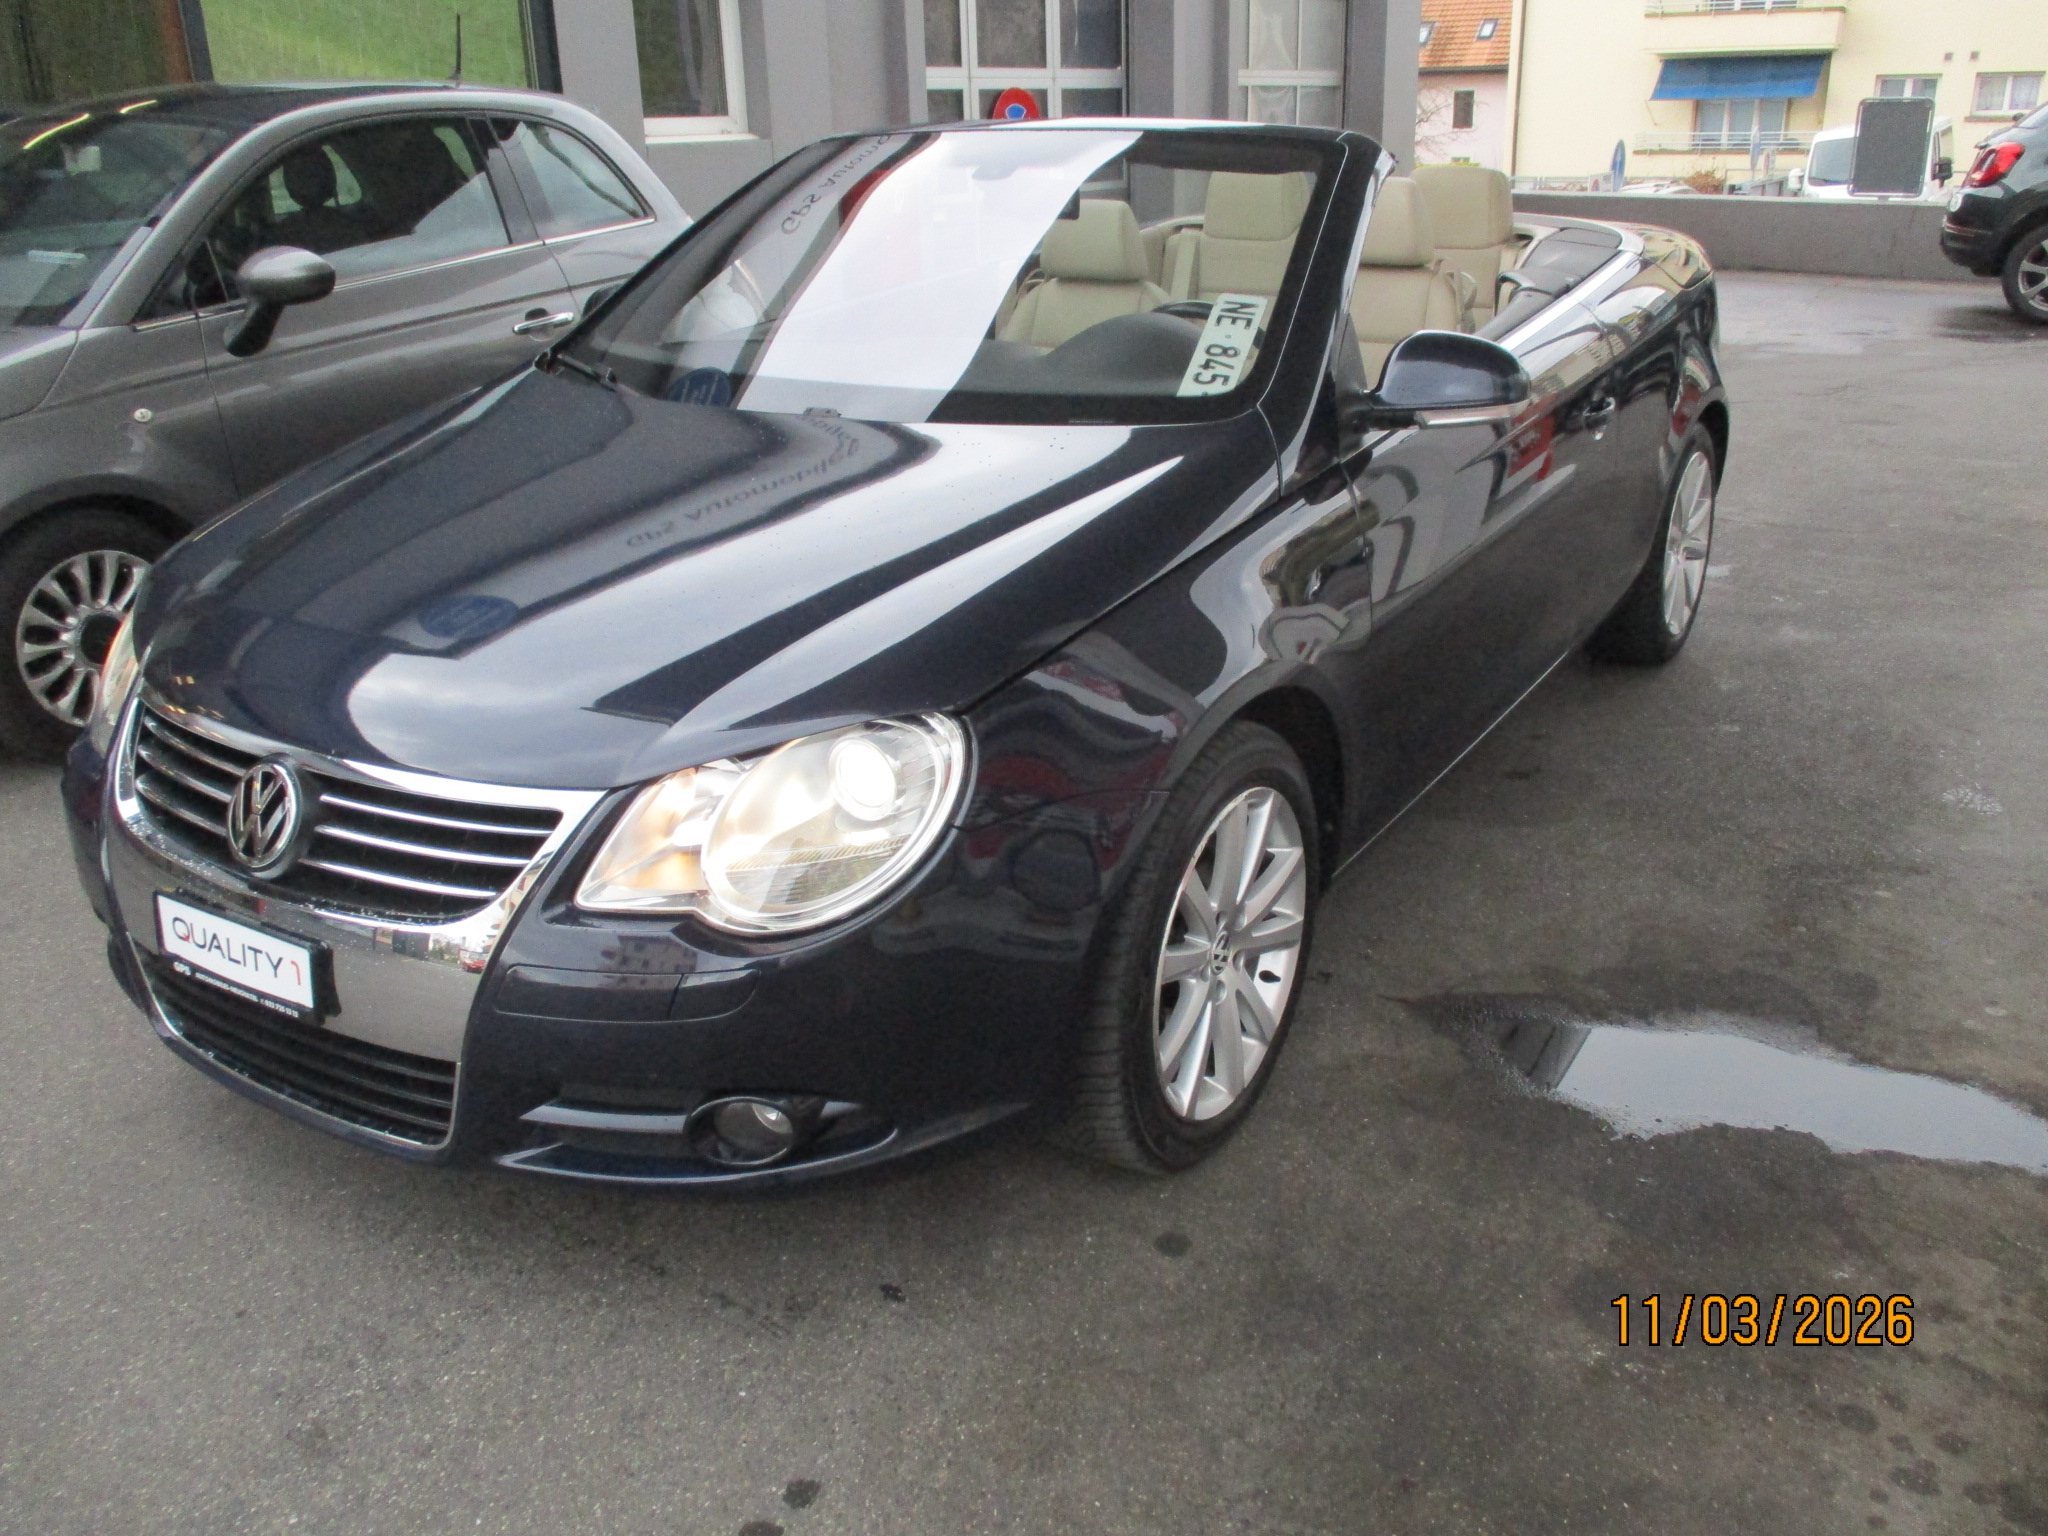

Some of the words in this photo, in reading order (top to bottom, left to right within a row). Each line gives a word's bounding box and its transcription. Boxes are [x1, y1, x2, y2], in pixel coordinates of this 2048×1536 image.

[1215, 300, 1259, 330] NE
[1193, 343, 1240, 386] 845
[171, 916, 284, 979] QUALITY
